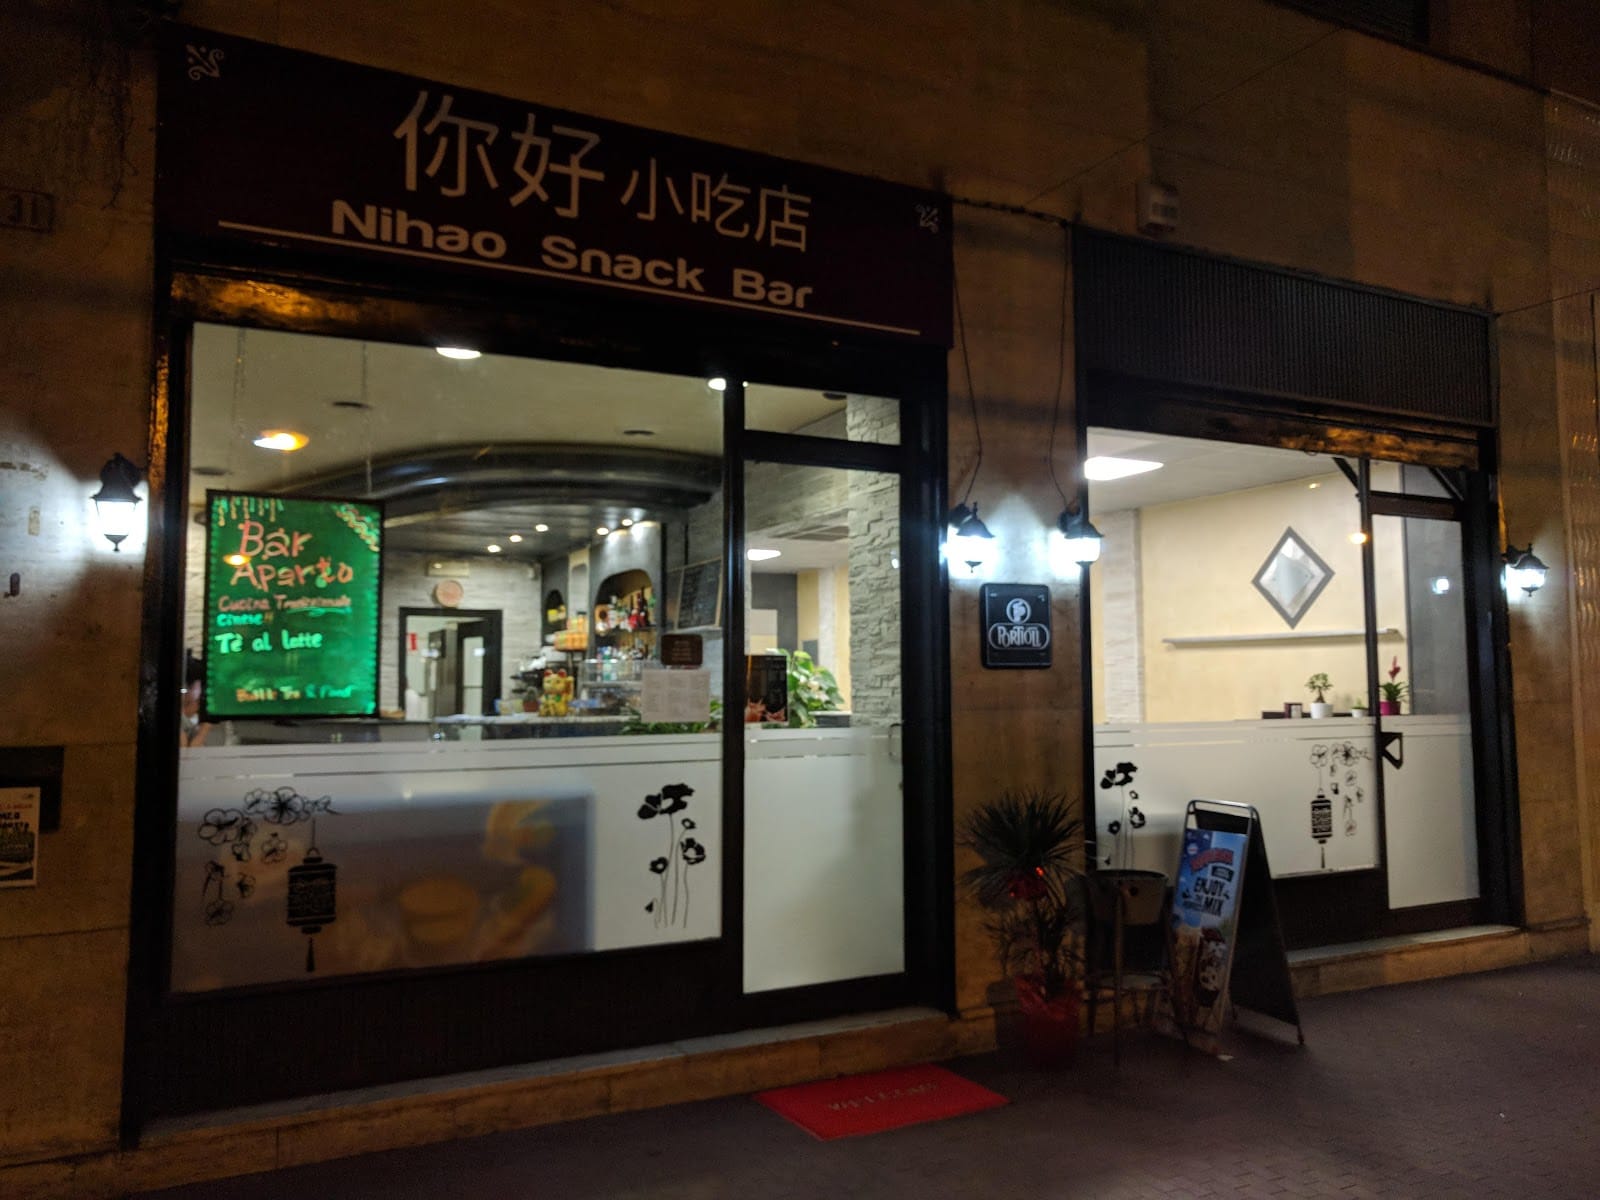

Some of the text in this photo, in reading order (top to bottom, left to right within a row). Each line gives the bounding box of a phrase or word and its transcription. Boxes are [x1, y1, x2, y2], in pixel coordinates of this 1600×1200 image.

[331, 199, 813, 309] Nihao Snack Bar
[238, 520, 313, 559] Bar
[252, 631, 273, 652] al
